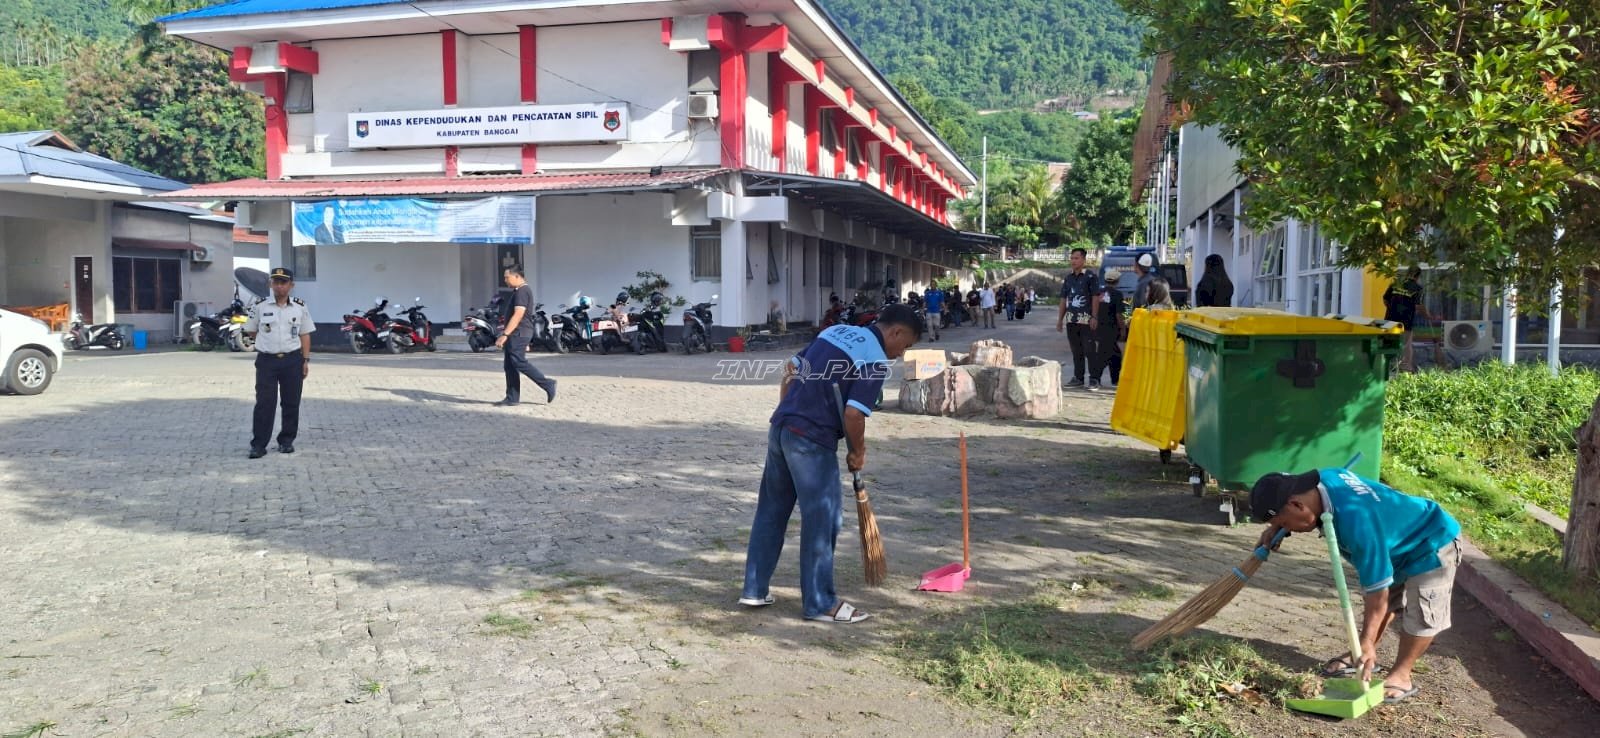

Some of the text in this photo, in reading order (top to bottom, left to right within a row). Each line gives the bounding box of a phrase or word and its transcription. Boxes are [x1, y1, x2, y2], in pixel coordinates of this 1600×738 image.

[375, 110, 599, 127] DINAS KEPENDUDUKAN DAN PENCATATAN SIPIL
[436, 128, 519, 137] KABUPATEN BANGGAI
